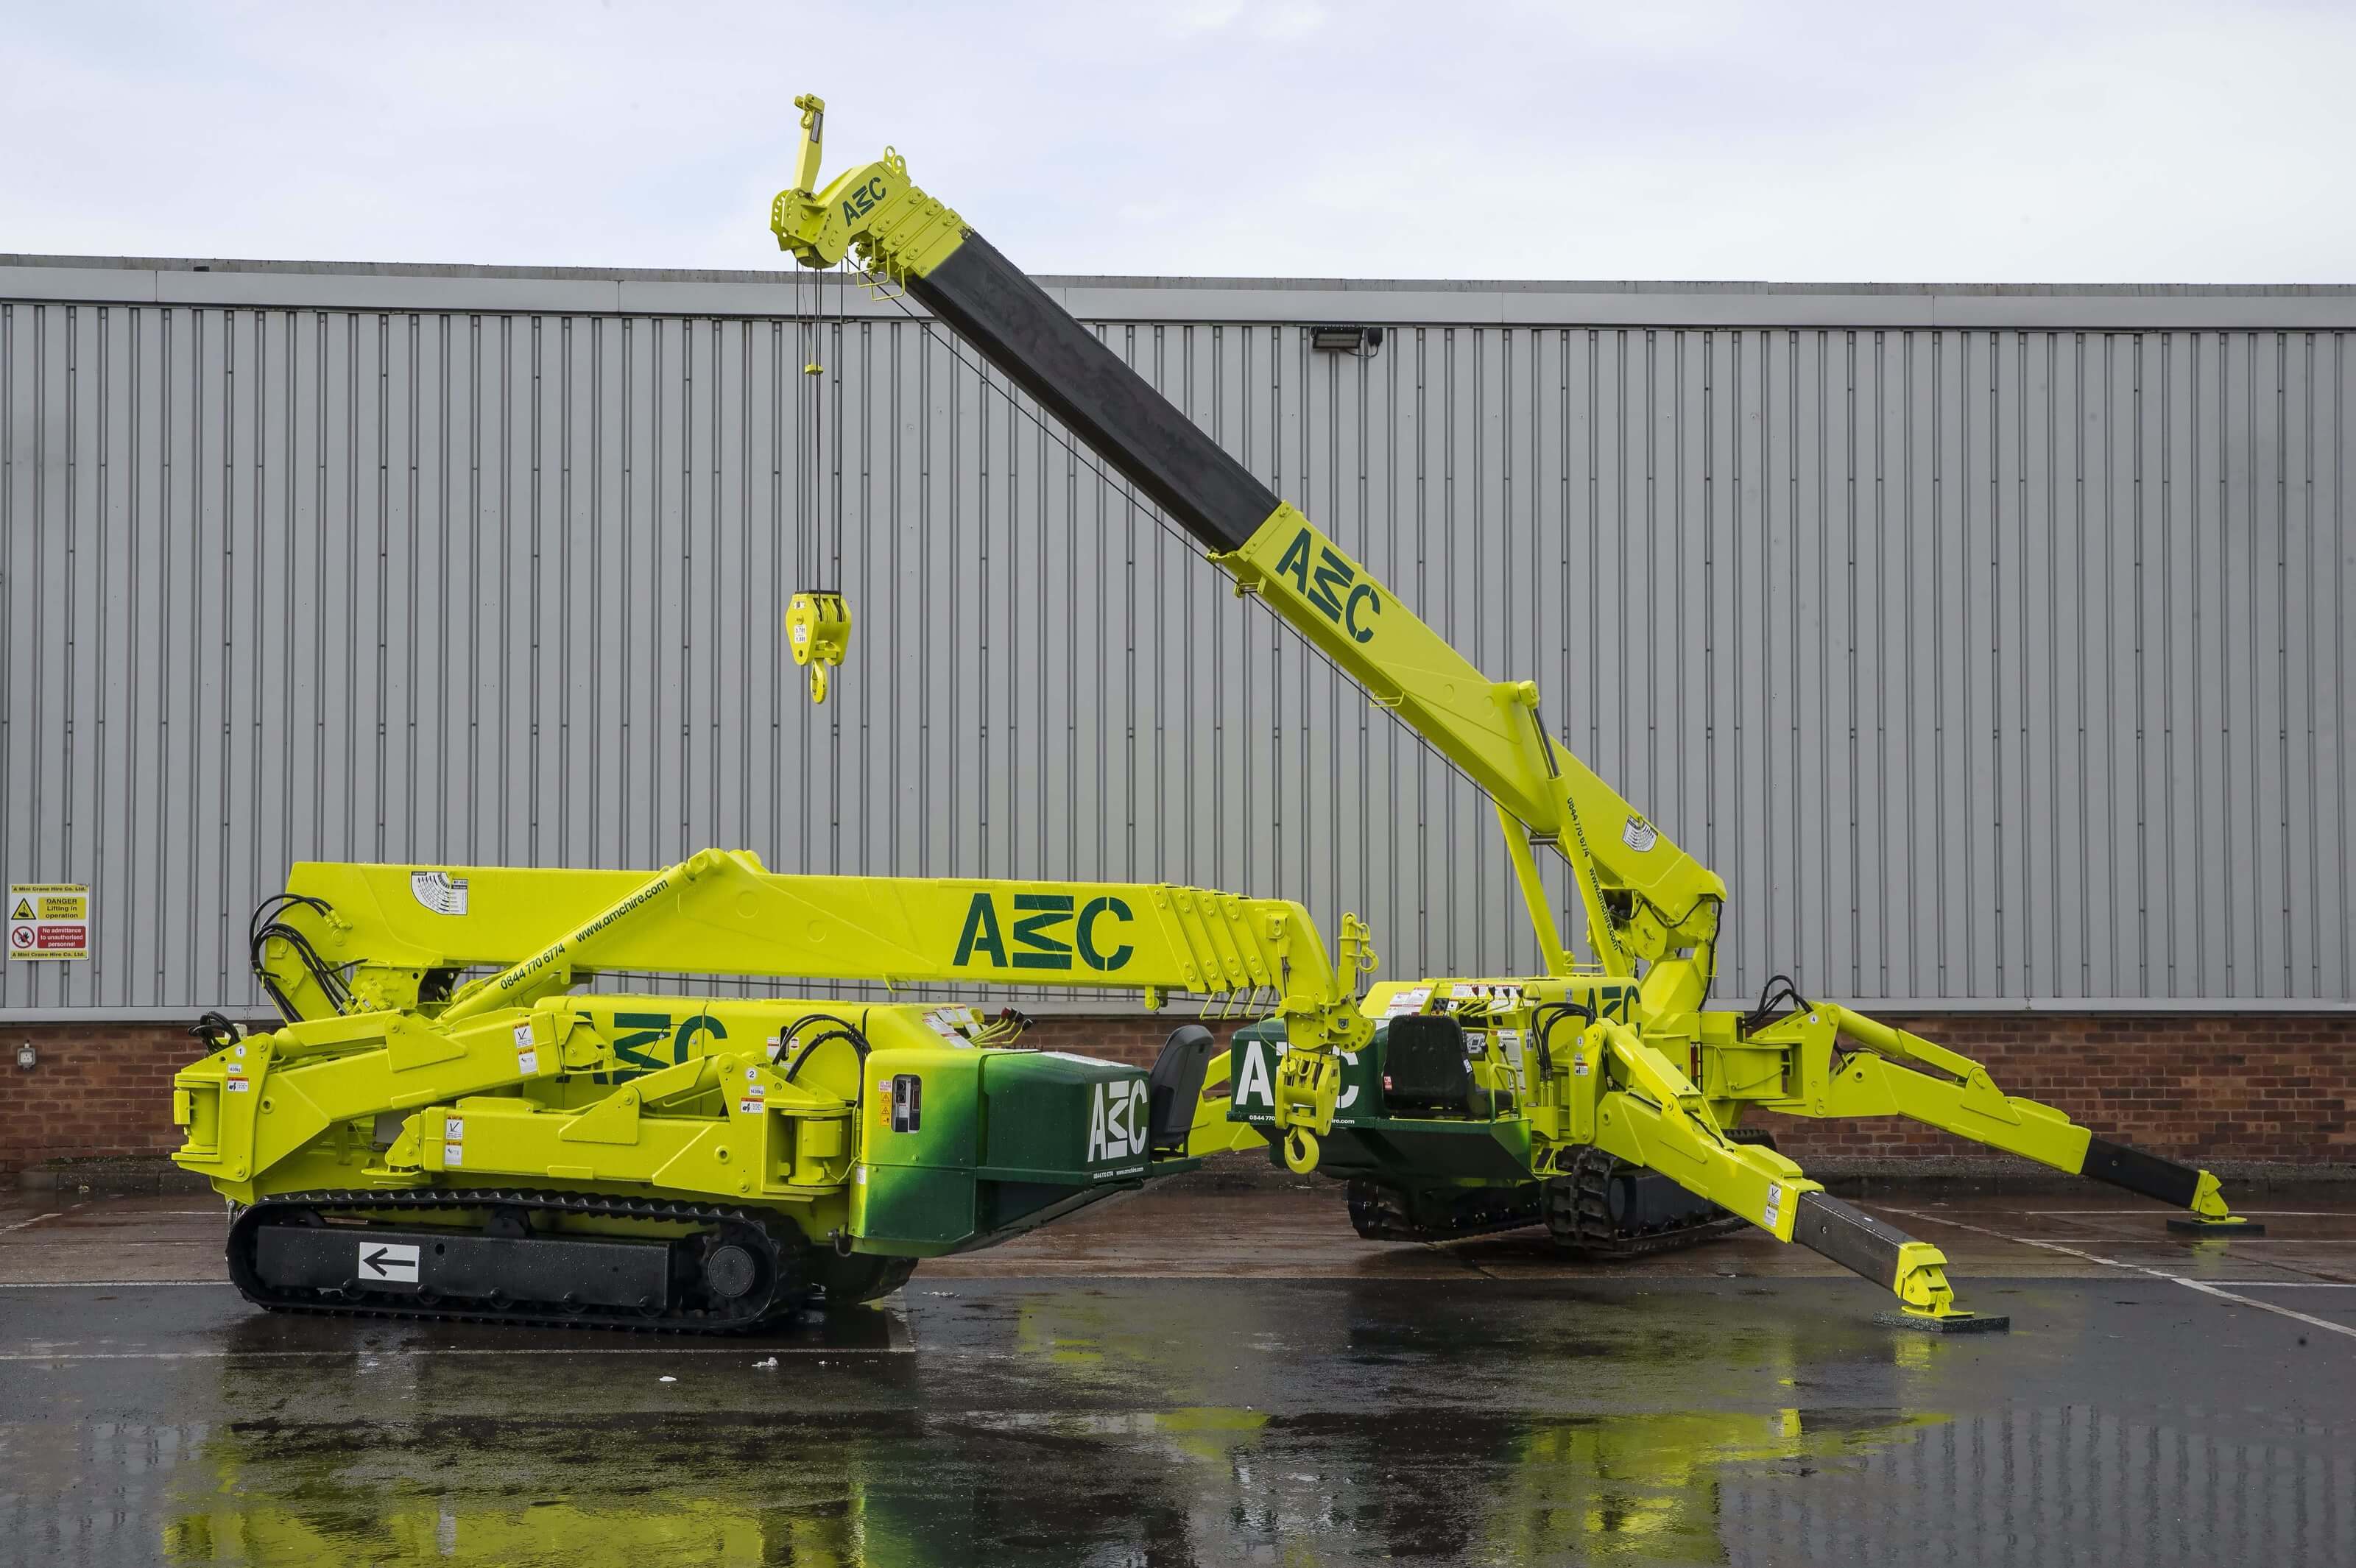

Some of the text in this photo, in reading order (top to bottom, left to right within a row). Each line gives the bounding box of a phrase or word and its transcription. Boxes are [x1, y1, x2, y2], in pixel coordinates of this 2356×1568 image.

[1274, 527, 1380, 643] AMC
[499, 878, 669, 990] 0844 770 6774 www.amchire.com
[952, 892, 1135, 972] AMC
[1589, 866, 1619, 951] www.amchire.com
[555, 1011, 728, 1086] MC
[749, 1070, 755, 1078] 2
[1235, 1040, 1359, 1109] AC
[1087, 1078, 1148, 1162] AMC
